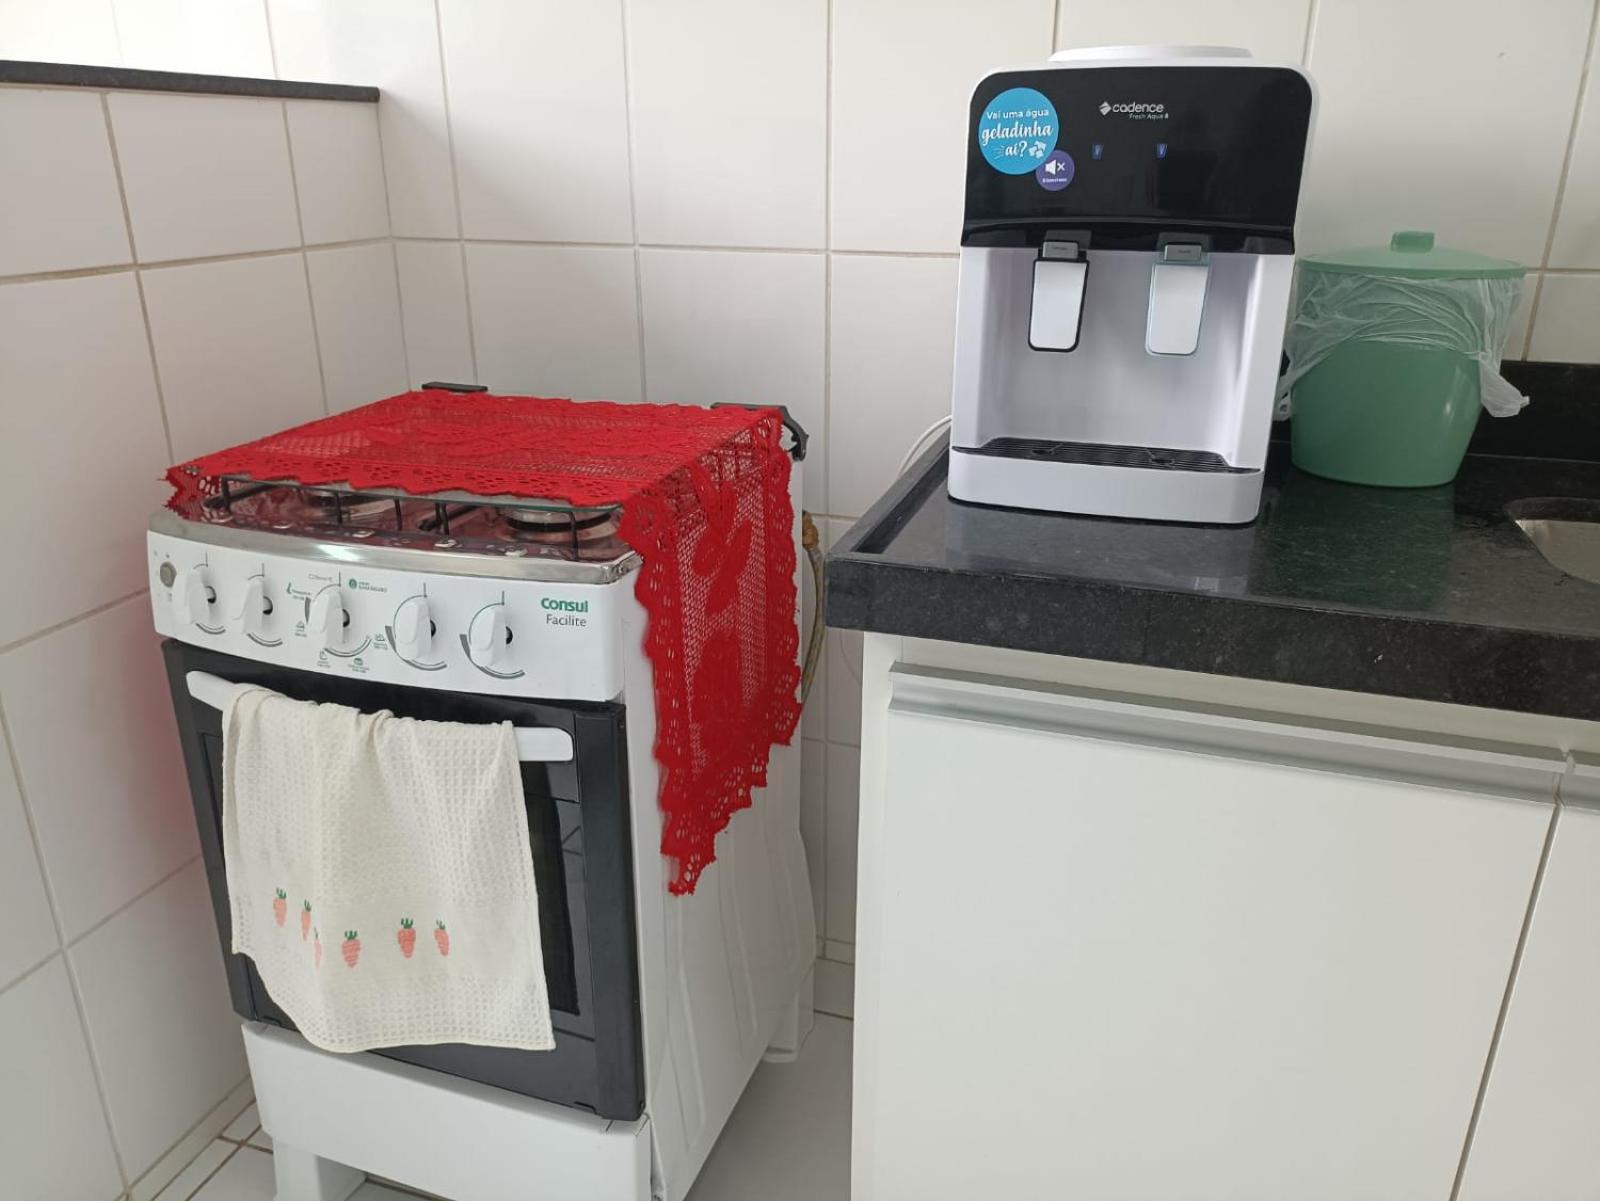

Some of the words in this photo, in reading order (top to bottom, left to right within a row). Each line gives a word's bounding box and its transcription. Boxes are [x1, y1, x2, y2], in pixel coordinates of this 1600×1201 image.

[1112, 101, 1164, 113] cadence
[981, 120, 1053, 147] geladinha
[546, 613, 587, 627] Facilite
